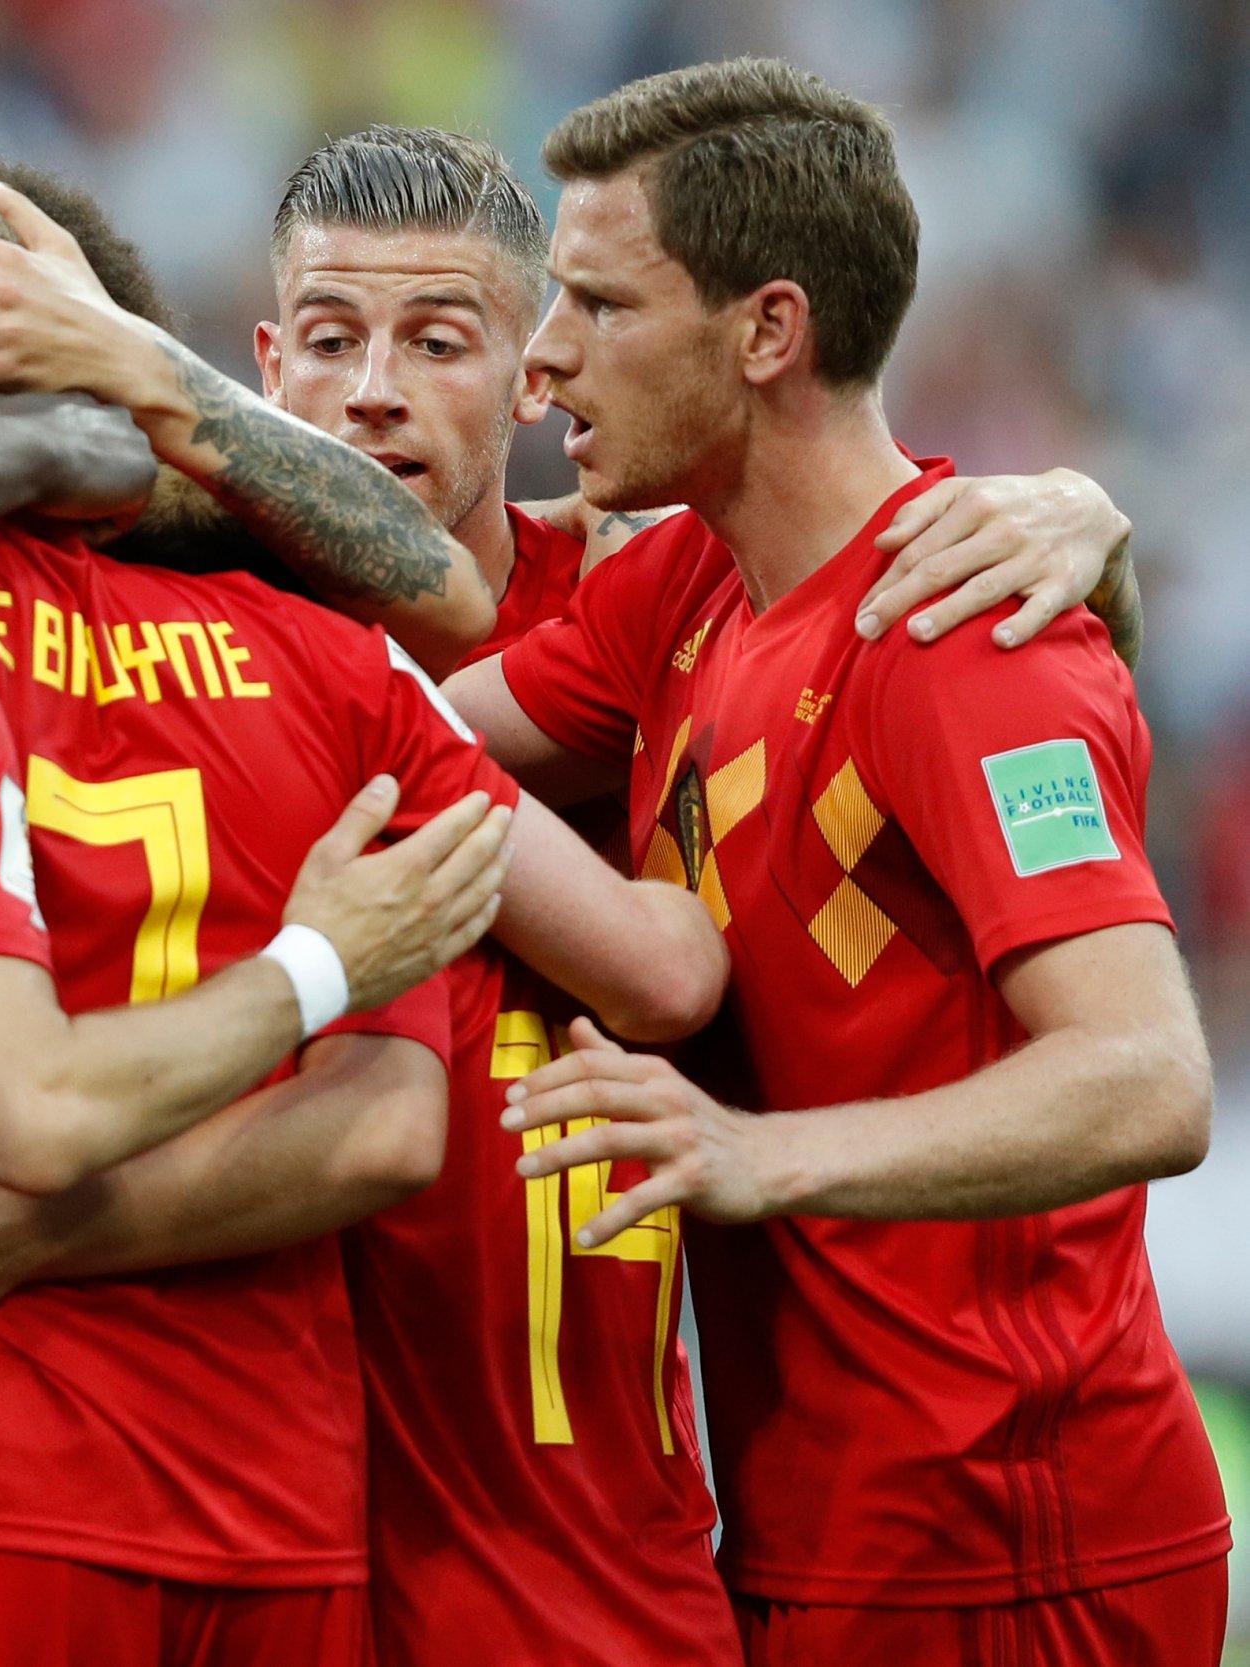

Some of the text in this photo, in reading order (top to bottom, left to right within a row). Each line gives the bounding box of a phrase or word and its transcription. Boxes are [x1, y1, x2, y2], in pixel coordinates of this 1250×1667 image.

[1003, 776, 1090, 804] LIVING
[1072, 814, 1100, 828] FIFA
[26, 753, 211, 1006] 7
[489, 1010, 681, 1456] 14
